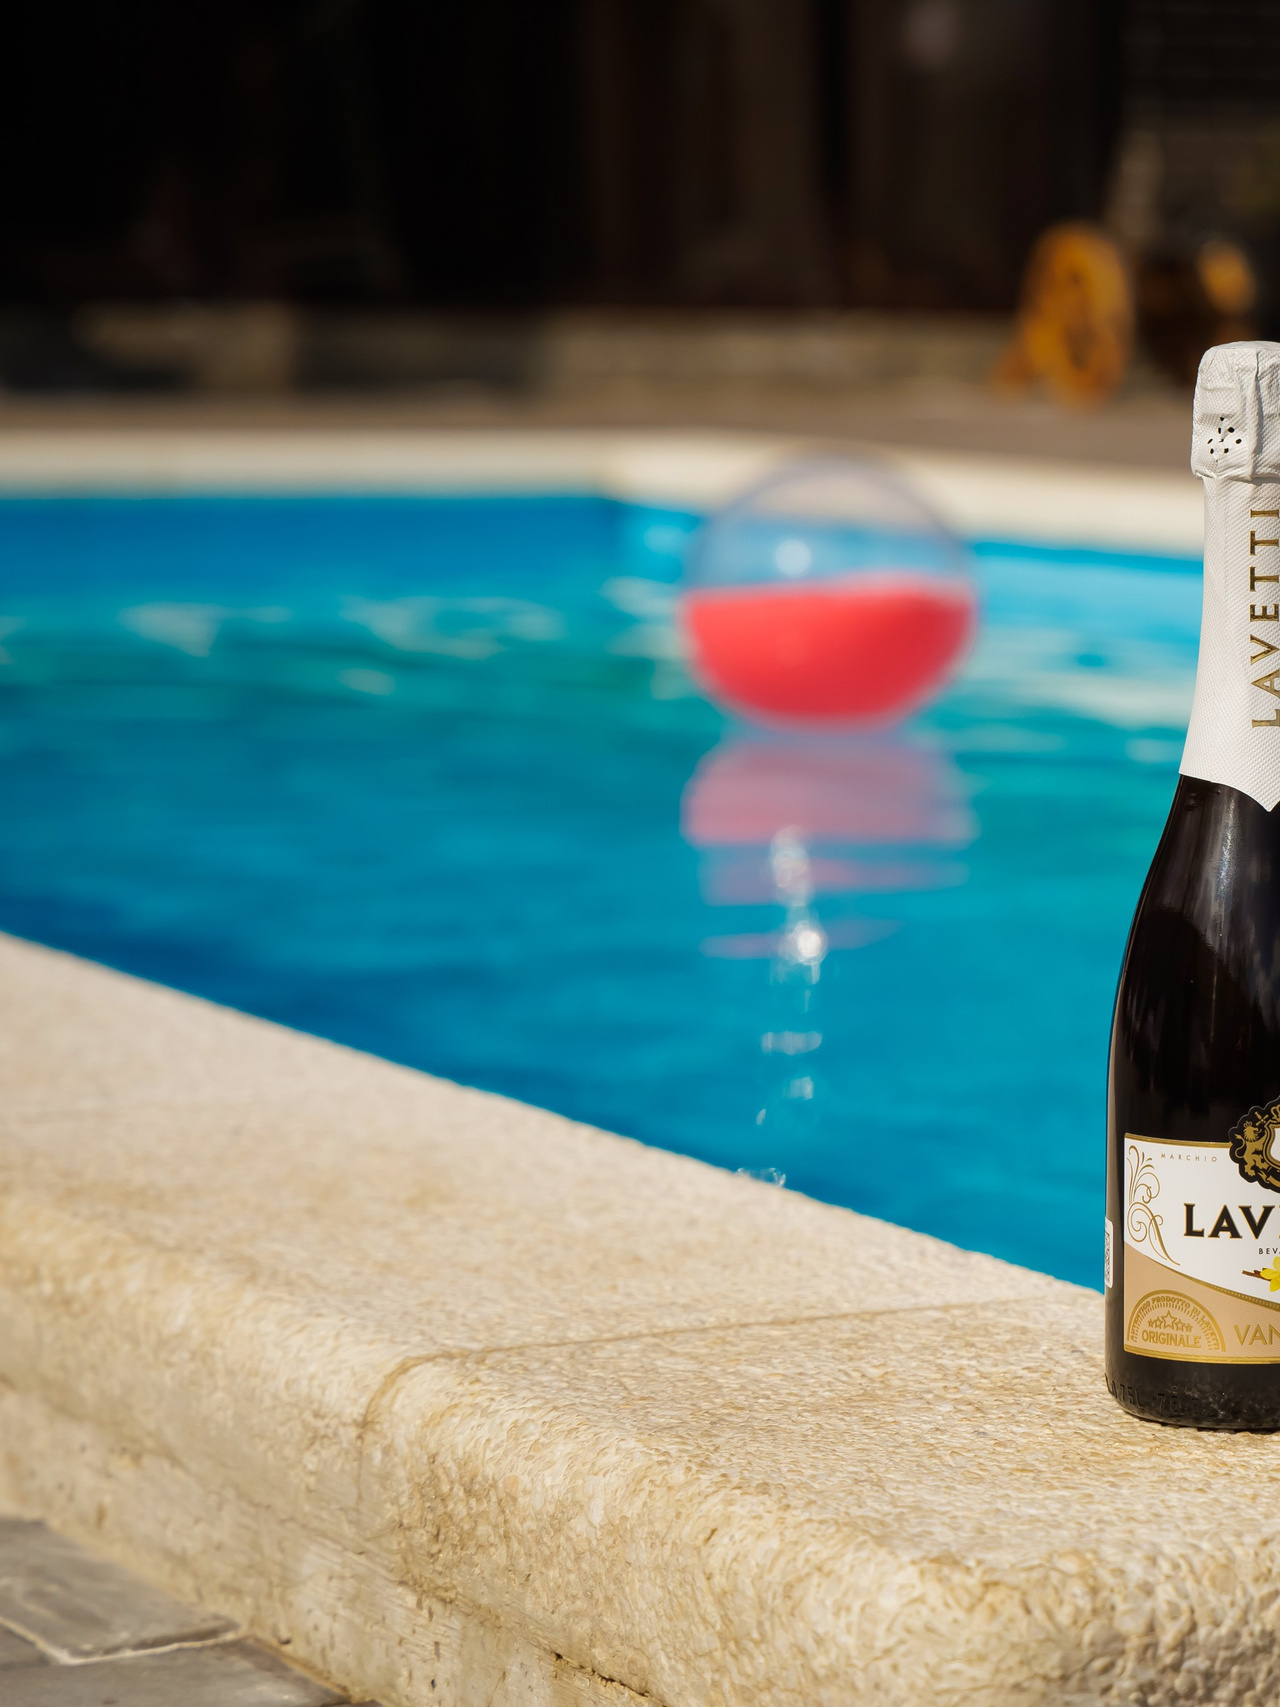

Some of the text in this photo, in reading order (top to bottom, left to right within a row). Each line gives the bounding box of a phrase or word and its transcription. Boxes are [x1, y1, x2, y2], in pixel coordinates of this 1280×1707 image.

[1250, 508, 1280, 728] LAVETTI
[1161, 1153, 1217, 1162] MARCHIO
[1151, 1295, 1191, 1310] PRODOTTO
[1141, 1329, 1201, 1349] ORIGINALE
